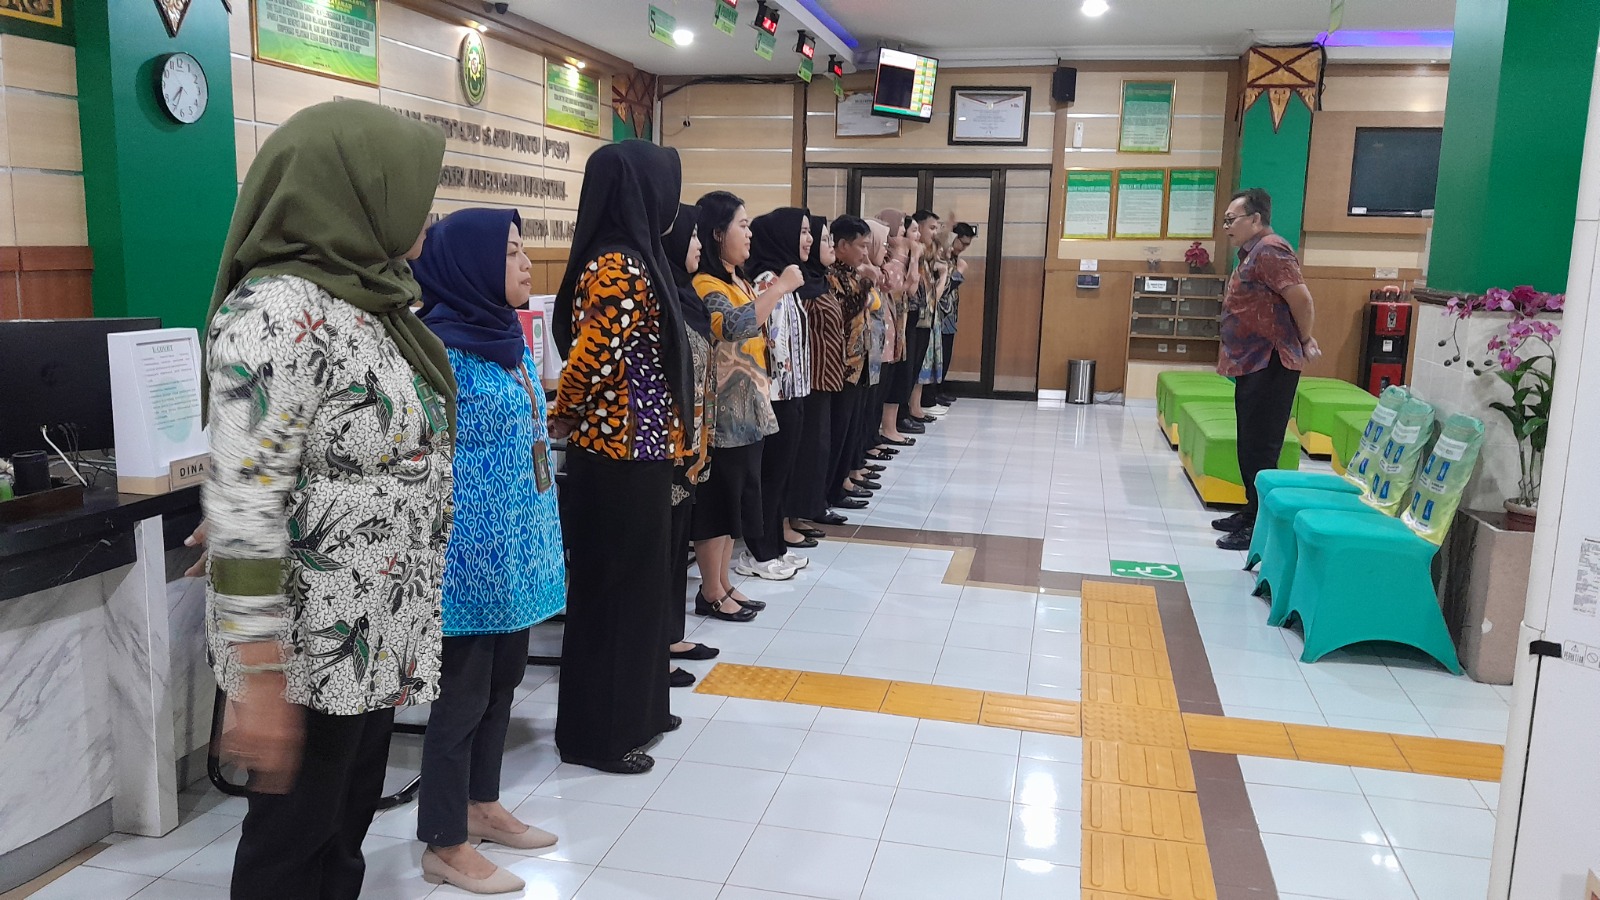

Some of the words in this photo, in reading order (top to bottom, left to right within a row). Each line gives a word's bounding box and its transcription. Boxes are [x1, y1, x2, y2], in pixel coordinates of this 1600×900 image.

[649, 9, 656, 34] 5
[169, 60, 175, 70] 11
[176, 57, 183, 69] 12
[163, 69, 170, 79] 10
[179, 108, 185, 118] 6
[179, 463, 204, 477] DINA
